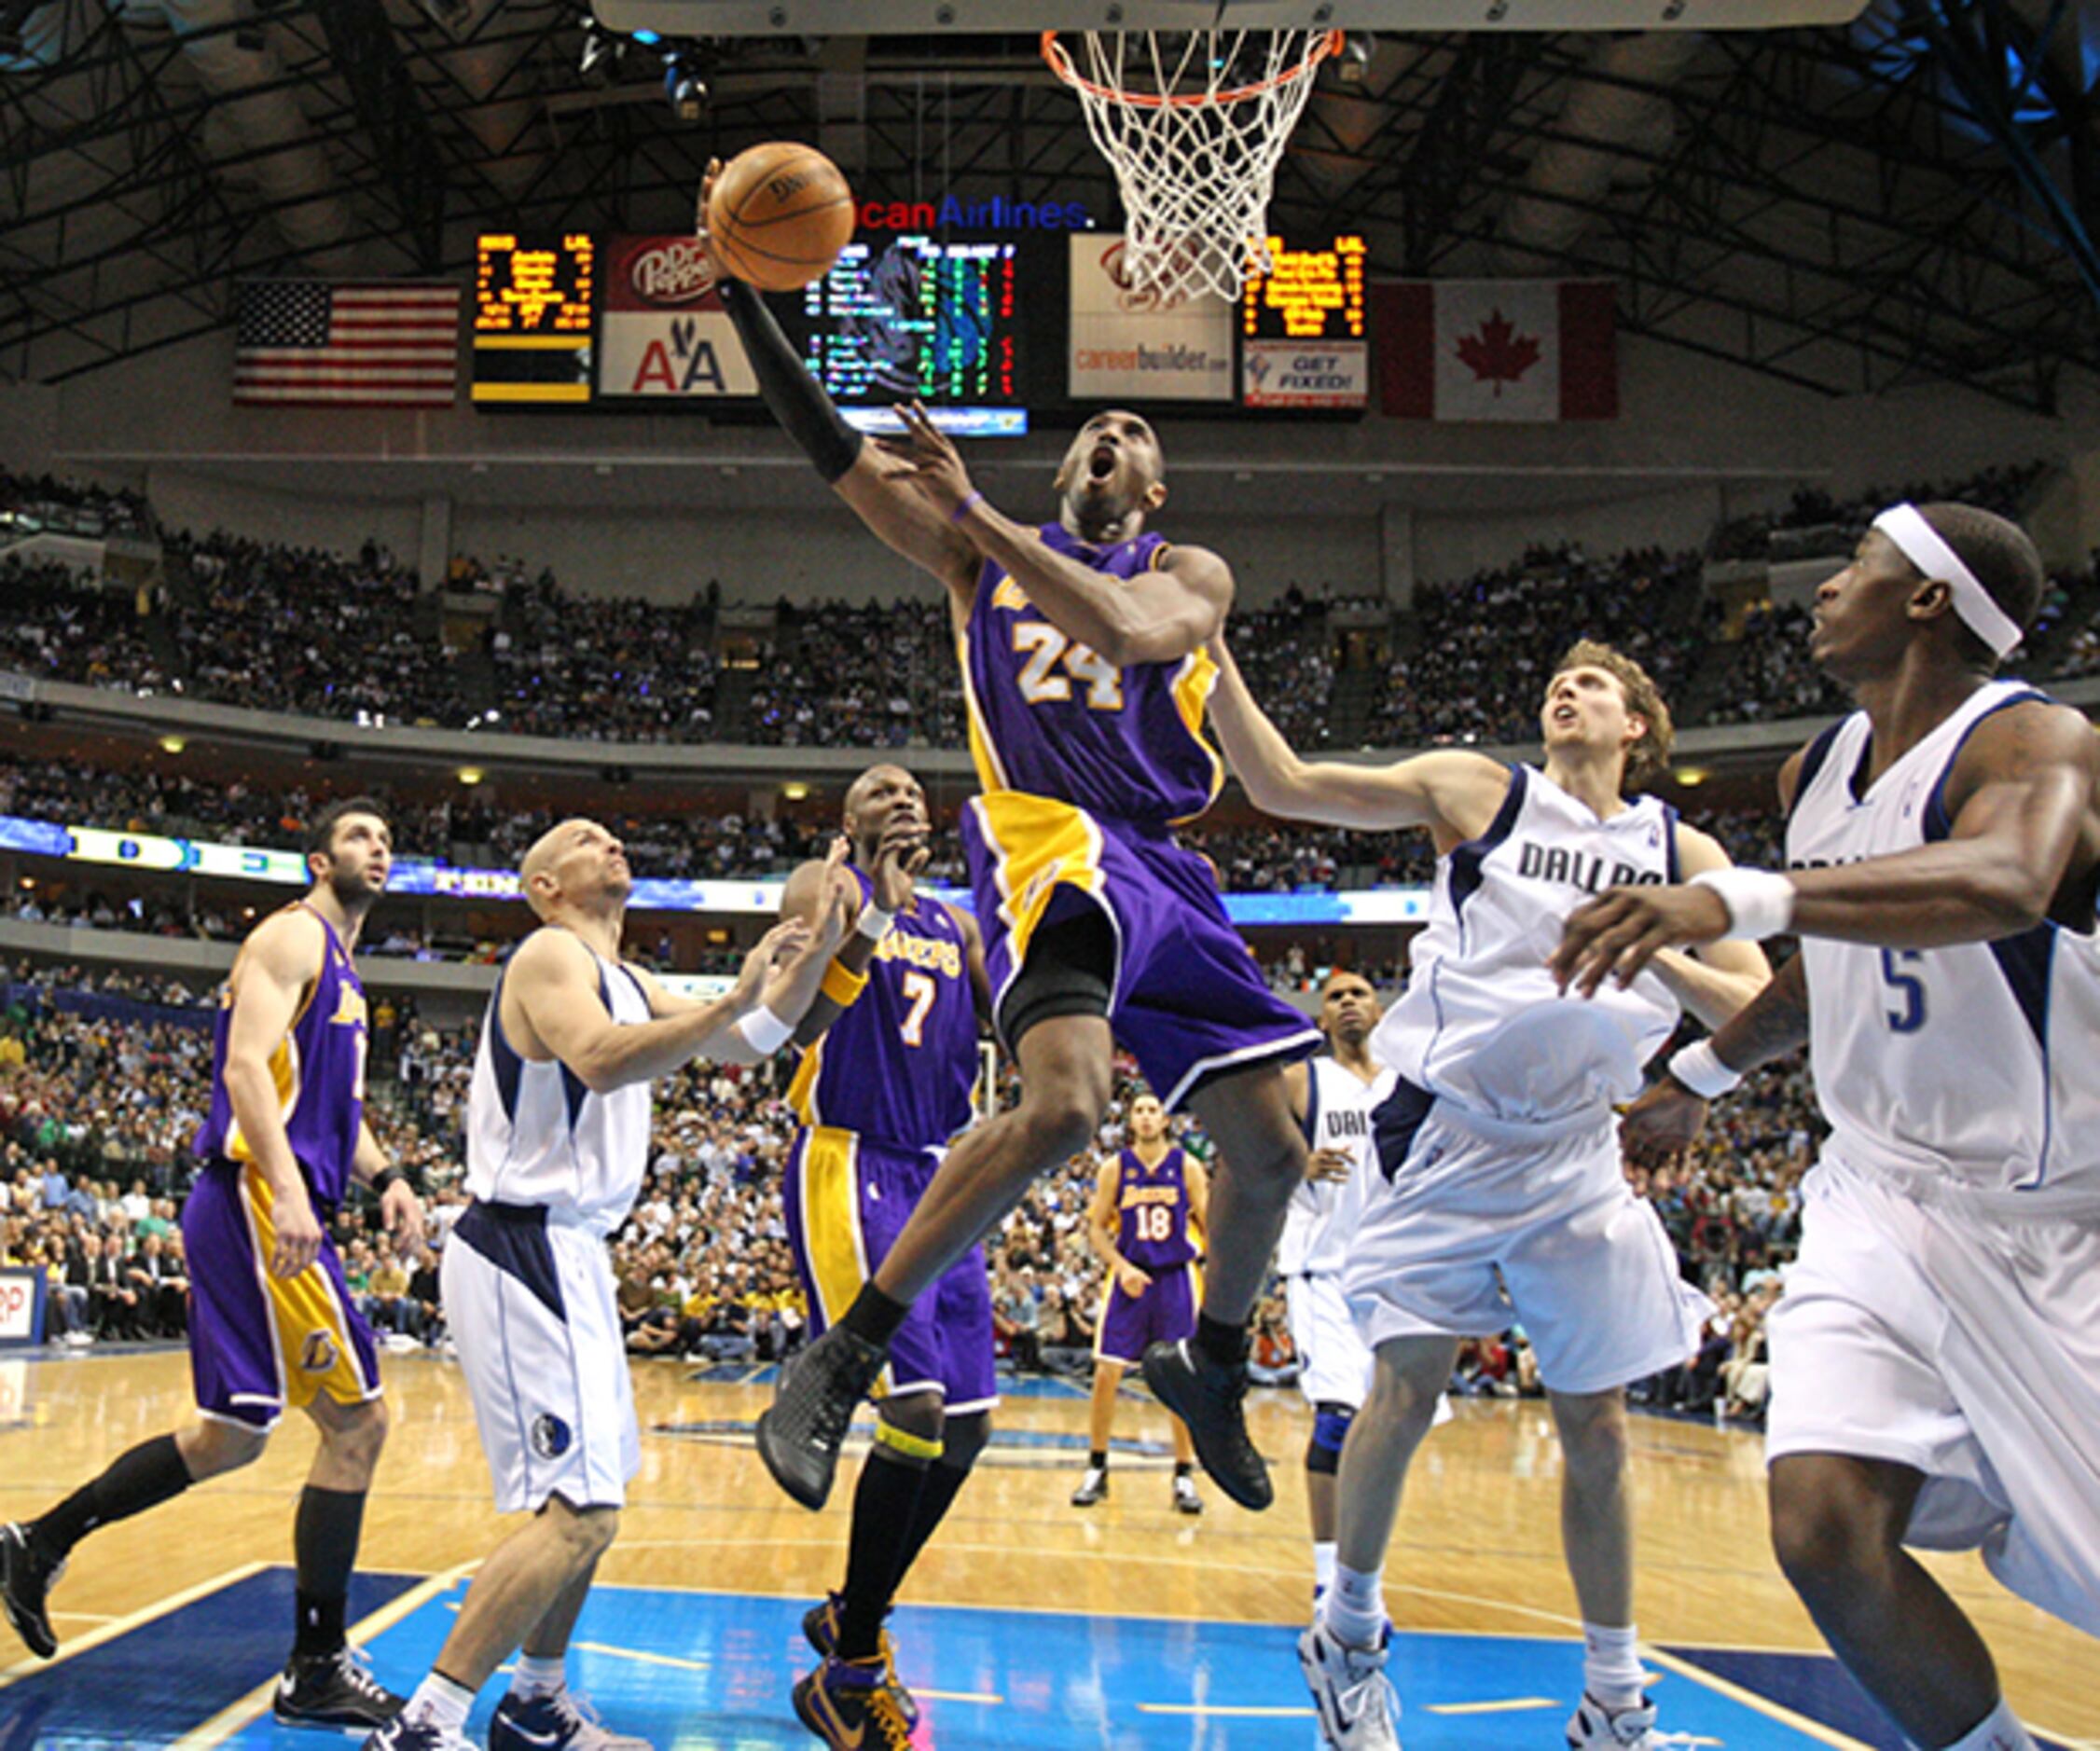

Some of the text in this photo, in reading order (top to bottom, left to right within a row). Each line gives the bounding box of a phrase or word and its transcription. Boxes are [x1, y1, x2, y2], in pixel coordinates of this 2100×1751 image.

[854, 195, 1087, 229] canAirlines
[1292, 356, 1339, 372] GET
[1012, 622, 1123, 710] 24
[900, 971, 935, 1047] 7
[1136, 1206, 1170, 1241] 18
